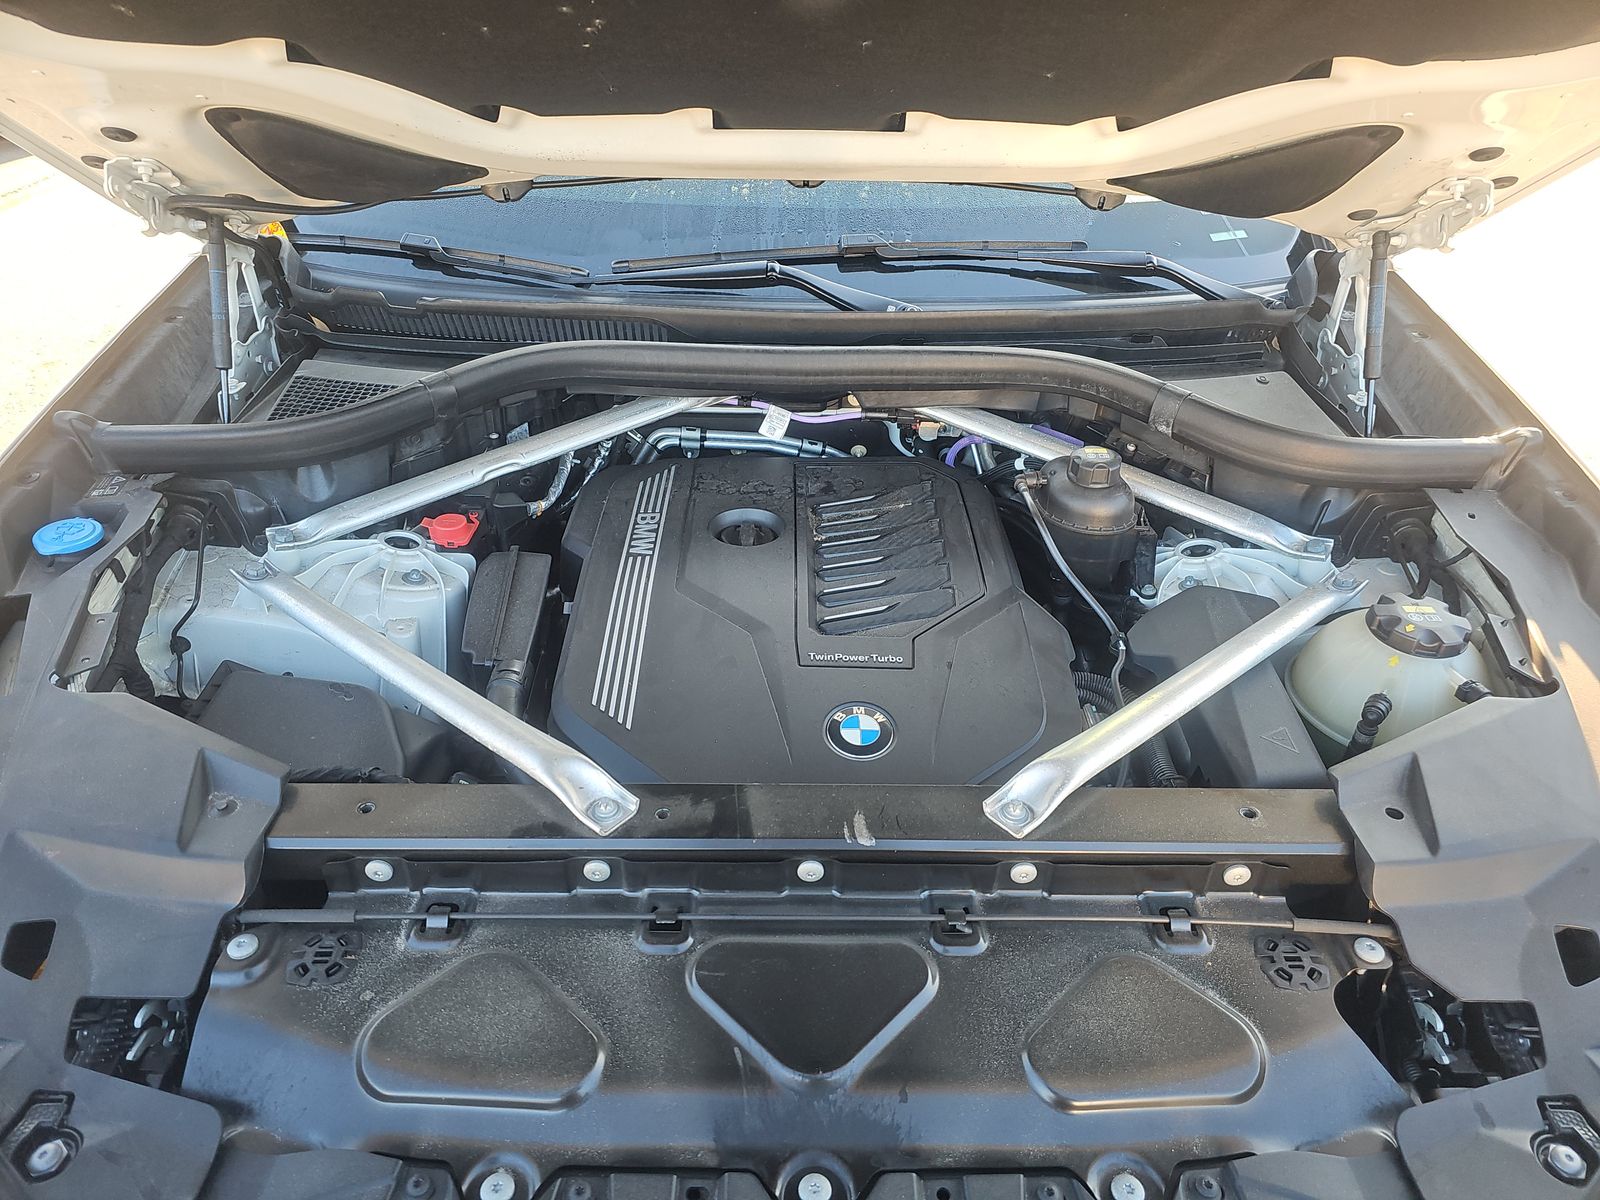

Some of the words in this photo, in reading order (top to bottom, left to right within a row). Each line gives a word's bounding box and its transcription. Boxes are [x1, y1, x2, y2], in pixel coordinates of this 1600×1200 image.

[629, 512, 660, 554] BMW
[808, 652, 869, 662] TwinPower
[870, 653, 903, 663] Turbo
[833, 706, 887, 722] BMW
